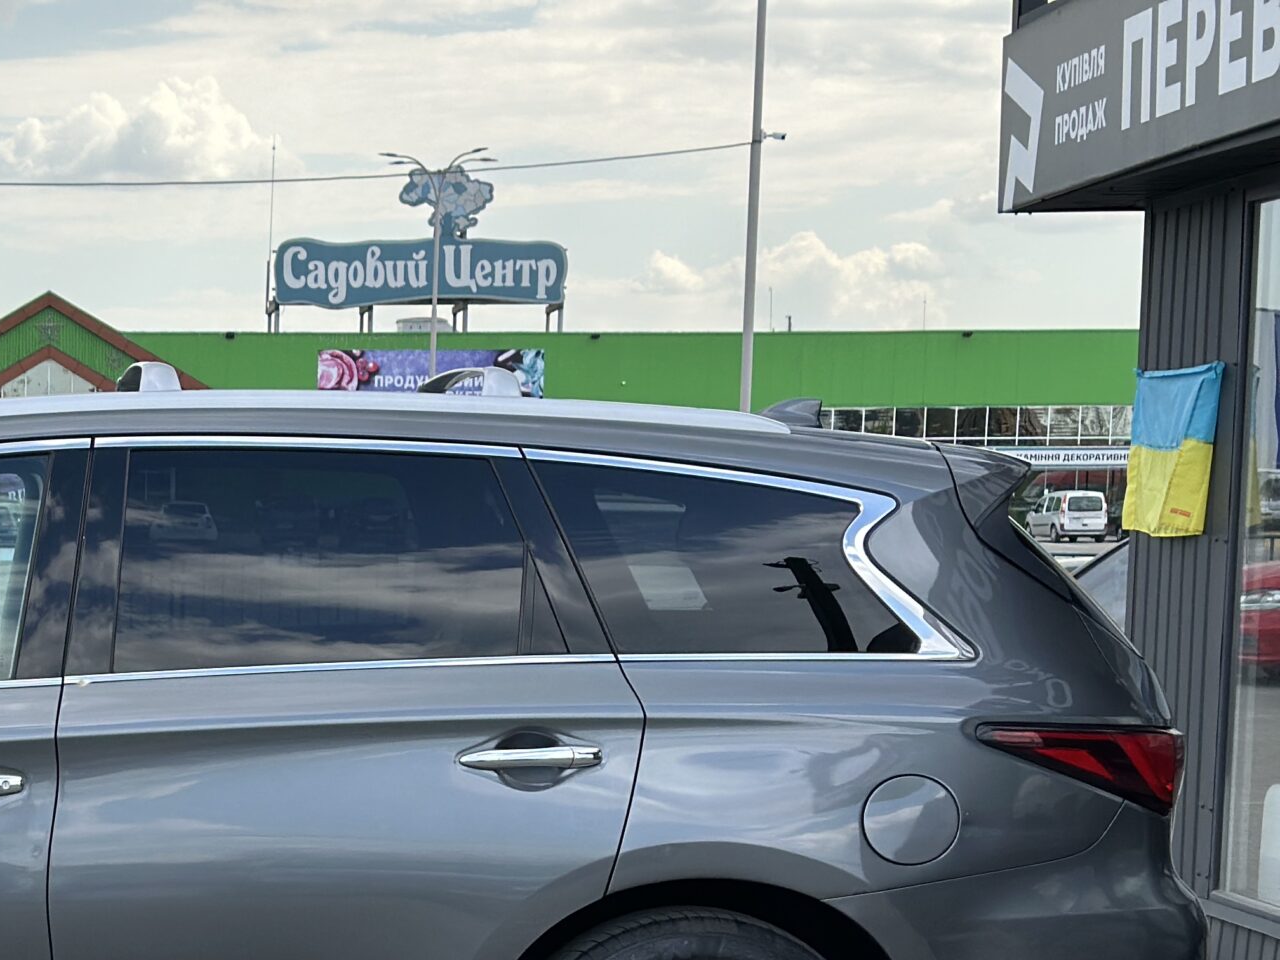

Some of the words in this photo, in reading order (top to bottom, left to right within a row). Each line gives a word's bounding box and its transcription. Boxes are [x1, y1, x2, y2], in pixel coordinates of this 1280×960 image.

[1056, 44, 1106, 93] КУПІВЛЯ
[1054, 97, 1107, 145] ПРОДАЖ
[283, 246, 428, 304] Садовий
[443, 245, 558, 299] Центр
